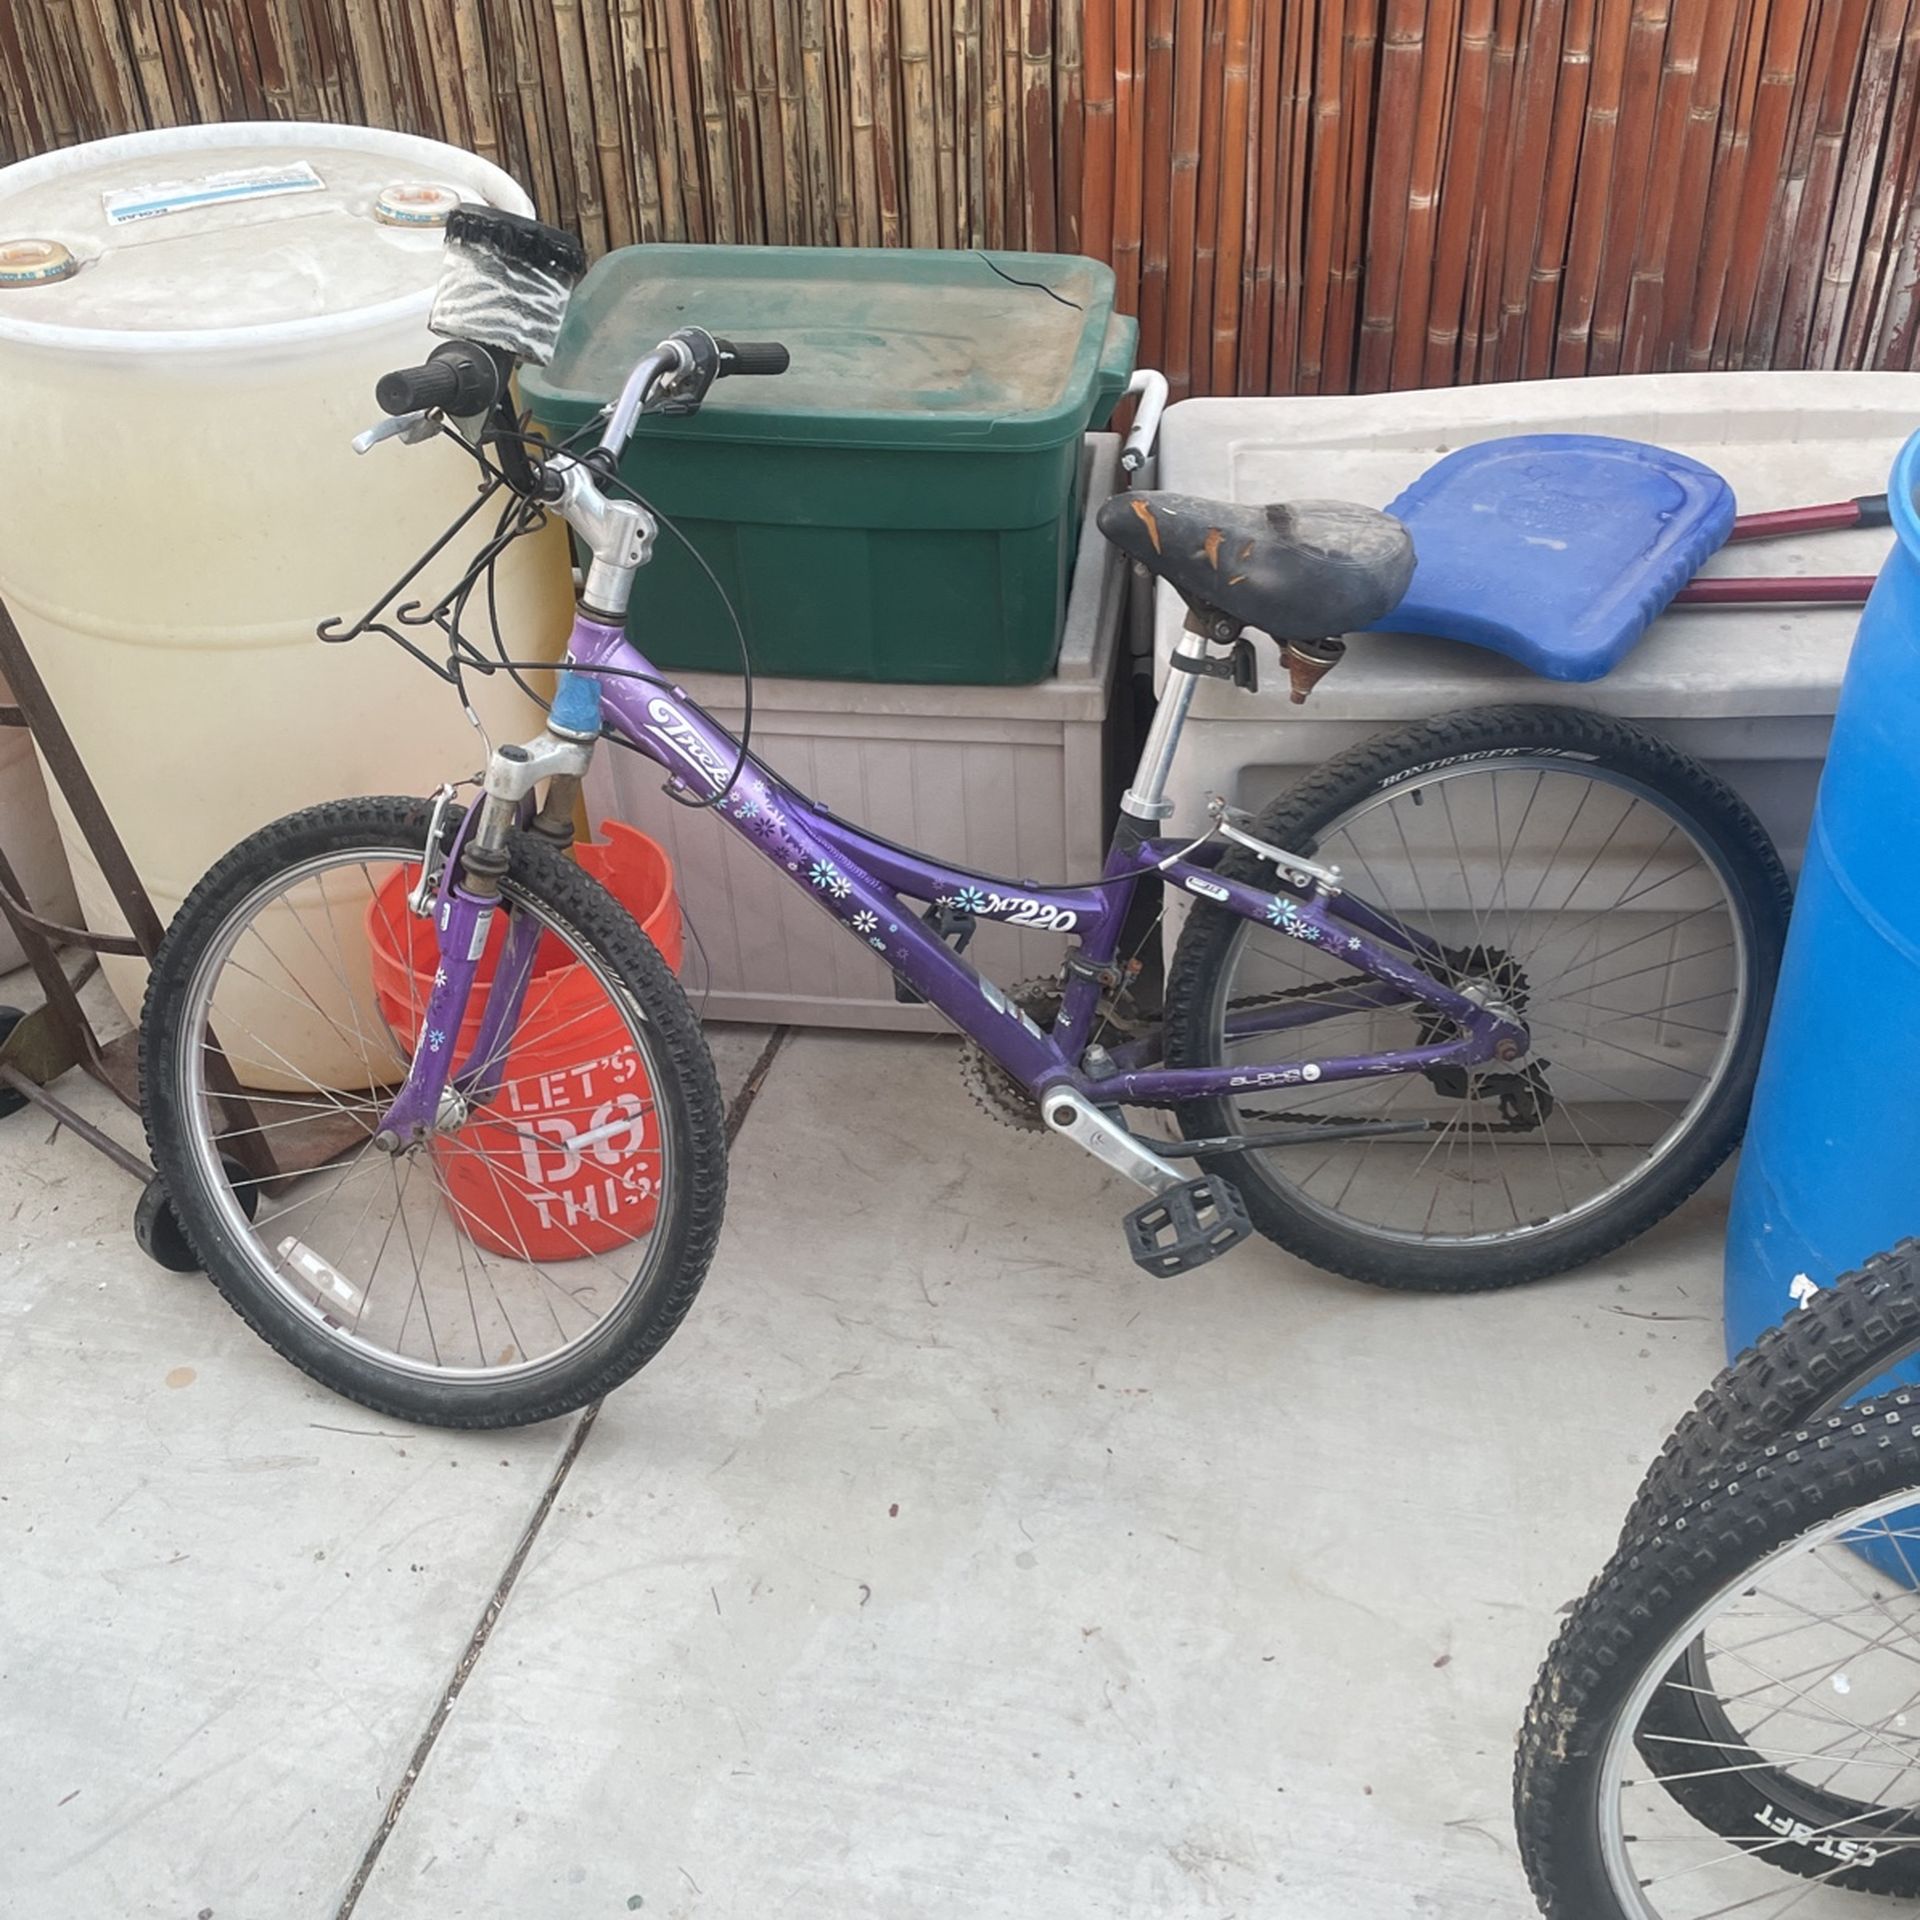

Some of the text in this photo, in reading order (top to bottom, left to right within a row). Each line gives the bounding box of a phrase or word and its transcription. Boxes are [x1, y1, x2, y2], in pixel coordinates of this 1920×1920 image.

[643, 698, 729, 793] Trek
[1378, 747, 1520, 788] BONTRAGER
[508, 1045, 637, 1113] LET'S
[516, 1093, 645, 1184] DO
[1814, 1834, 1878, 1868] CST
